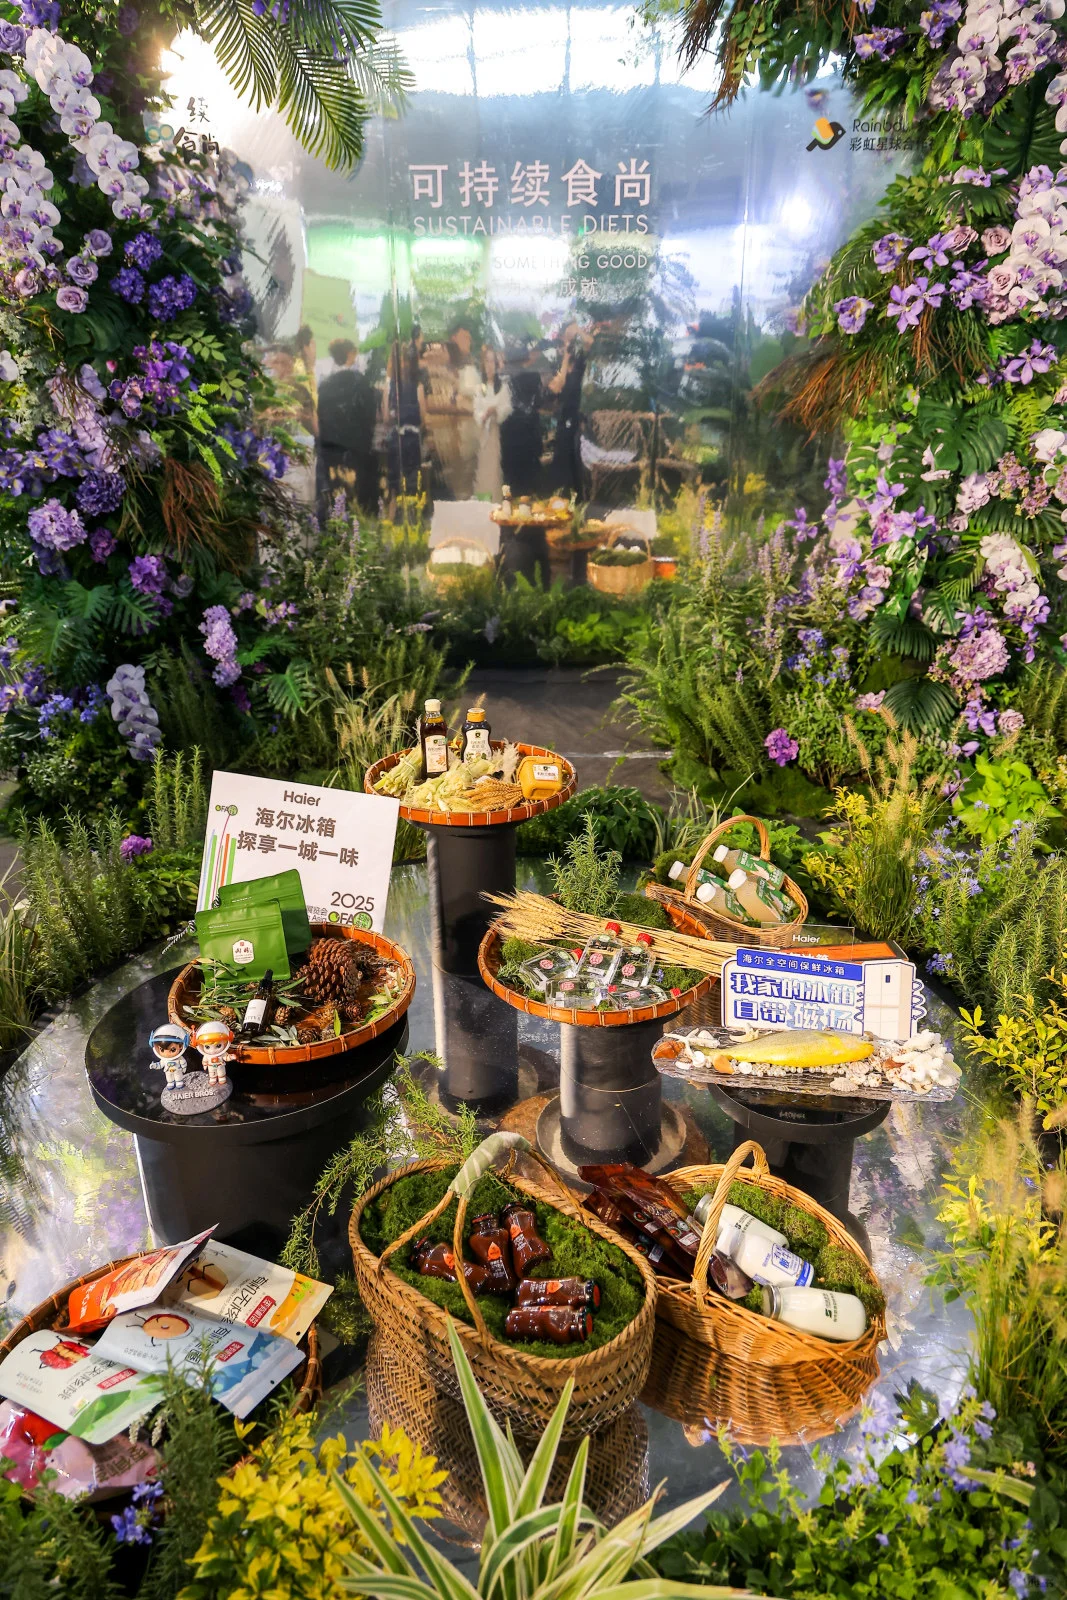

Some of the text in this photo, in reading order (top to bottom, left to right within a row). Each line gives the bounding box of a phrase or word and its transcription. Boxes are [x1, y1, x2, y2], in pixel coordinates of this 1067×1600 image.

[408, 158, 651, 208] 可持续食尚
[413, 214, 649, 236] SUSTAINABLE DIETS
[596, 254, 648, 269] GOOD
[283, 790, 321, 807] Haier
[255, 807, 337, 838] 海尔冰箱
[237, 830, 359, 867] 探享一城一味
[330, 891, 375, 912] 2025
[792, 934, 820, 943] Haier
[742, 954, 845, 976] 海尔全空间保鲜冰箱
[731, 972, 855, 1006] 我家的冰箱
[734, 998, 853, 1032] 自带磁场
[172, 1092, 194, 1101] HAIER
